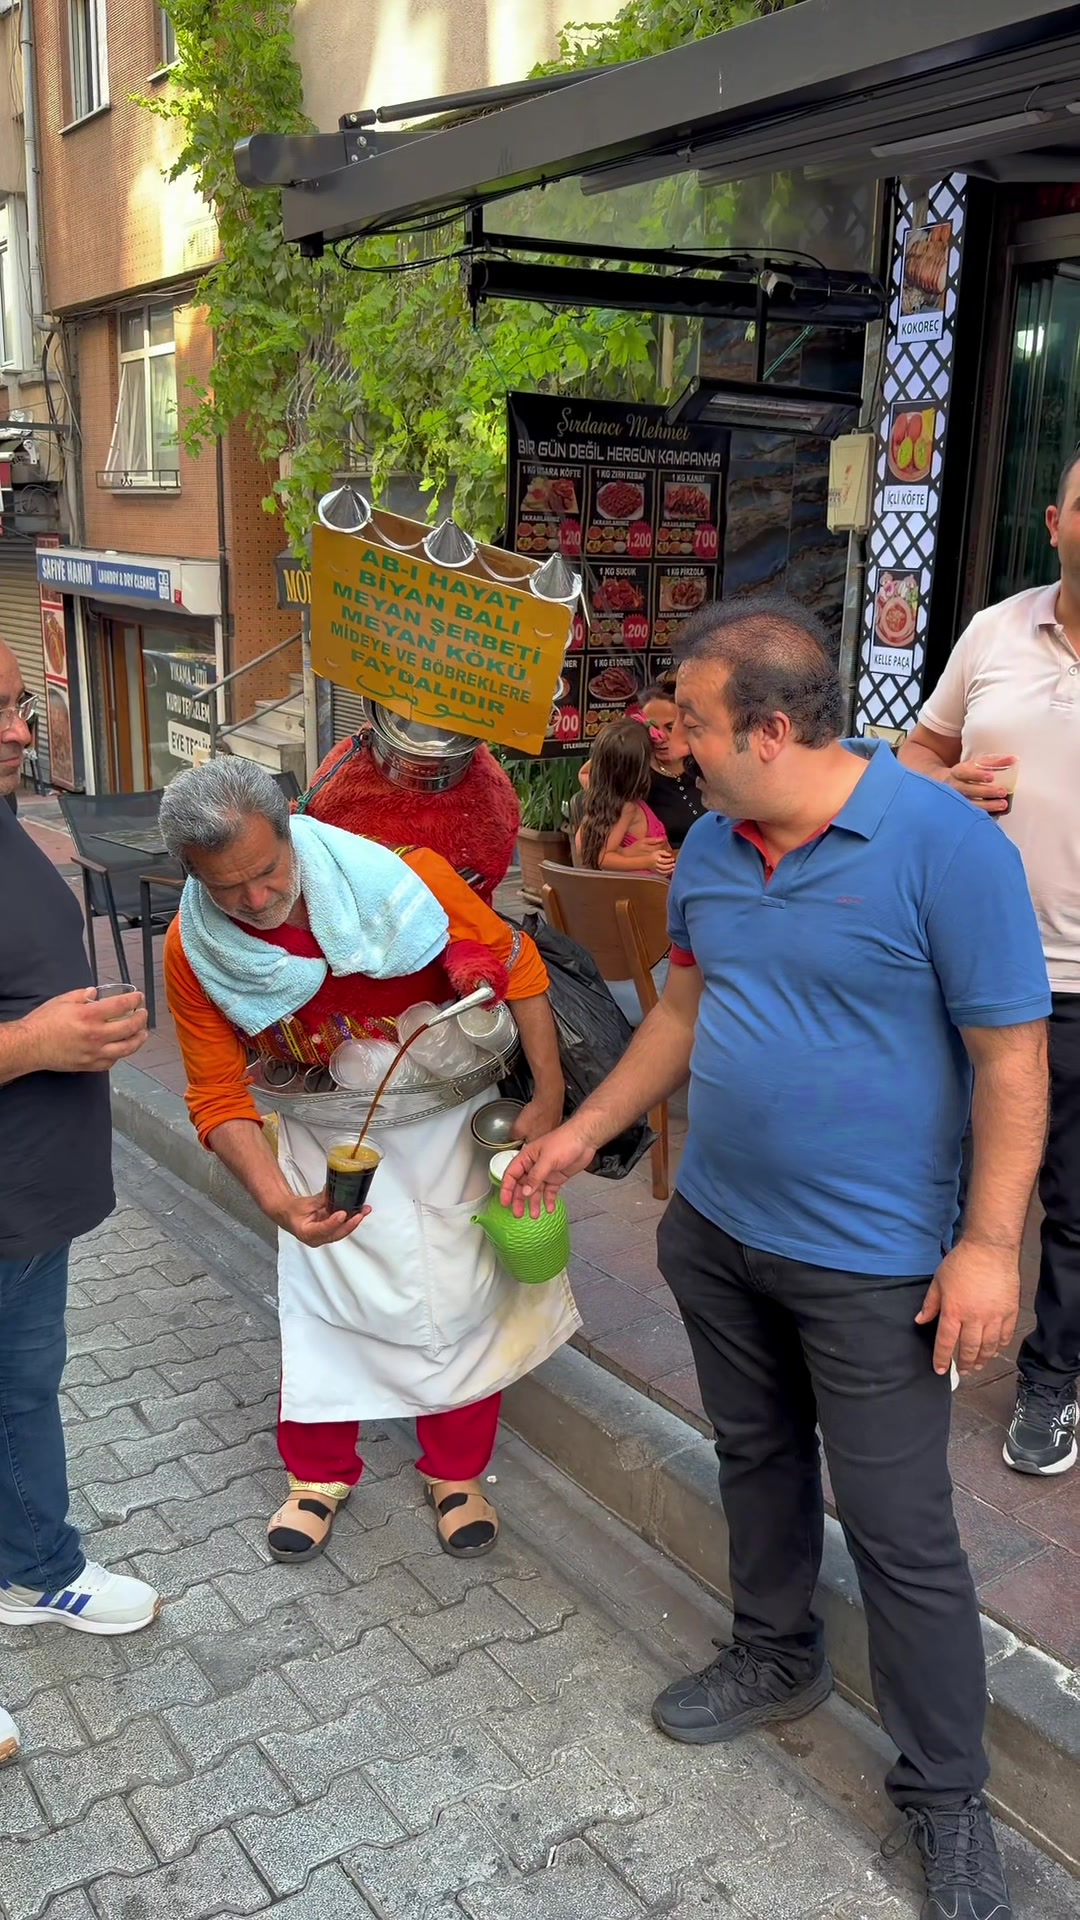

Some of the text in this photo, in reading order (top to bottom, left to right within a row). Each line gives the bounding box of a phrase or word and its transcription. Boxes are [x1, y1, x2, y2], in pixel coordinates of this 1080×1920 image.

[901, 319, 940, 335] KOKOREÇ
[557, 407, 691, 440] Şırdancı Mehmet
[538, 440, 566, 458] GÜN
[570, 441, 604, 461] DEĞİL
[607, 445, 655, 464] HERGÜN
[658, 450, 721, 467] KAMPANYA
[560, 467, 581, 478] KÖFTE
[600, 470, 610, 478] KG
[626, 471, 646, 480] KEBAP
[676, 474, 686, 482] KG
[887, 490, 924, 507] İÇLİ KÖFTE
[626, 532, 651, 548] 1.200
[695, 531, 717, 547] 700
[66, 560, 93, 586] HANIM
[599, 567, 636, 576] 1 KG SUCUK
[671, 568, 679, 576] KG
[680, 566, 704, 576] PİRZOLA
[98, 569, 157, 591] LAUNDRY & DRY CLEANER
[428, 571, 523, 611] HAYAT
[359, 569, 520, 636] BİYAN BALI
[333, 581, 541, 665] MEYAN ŞERBETİ
[341, 605, 527, 682] MEYAN KÖKÜ
[331, 620, 531, 704] MİDEYE VE BÖBREKLERE
[599, 659, 608, 667] KG
[874, 654, 910, 670] KELLE PAÇA
[169, 661, 192, 685] YIKAMA
[350, 649, 505, 716] FAYDALIDIR
[554, 715, 579, 732] 700
